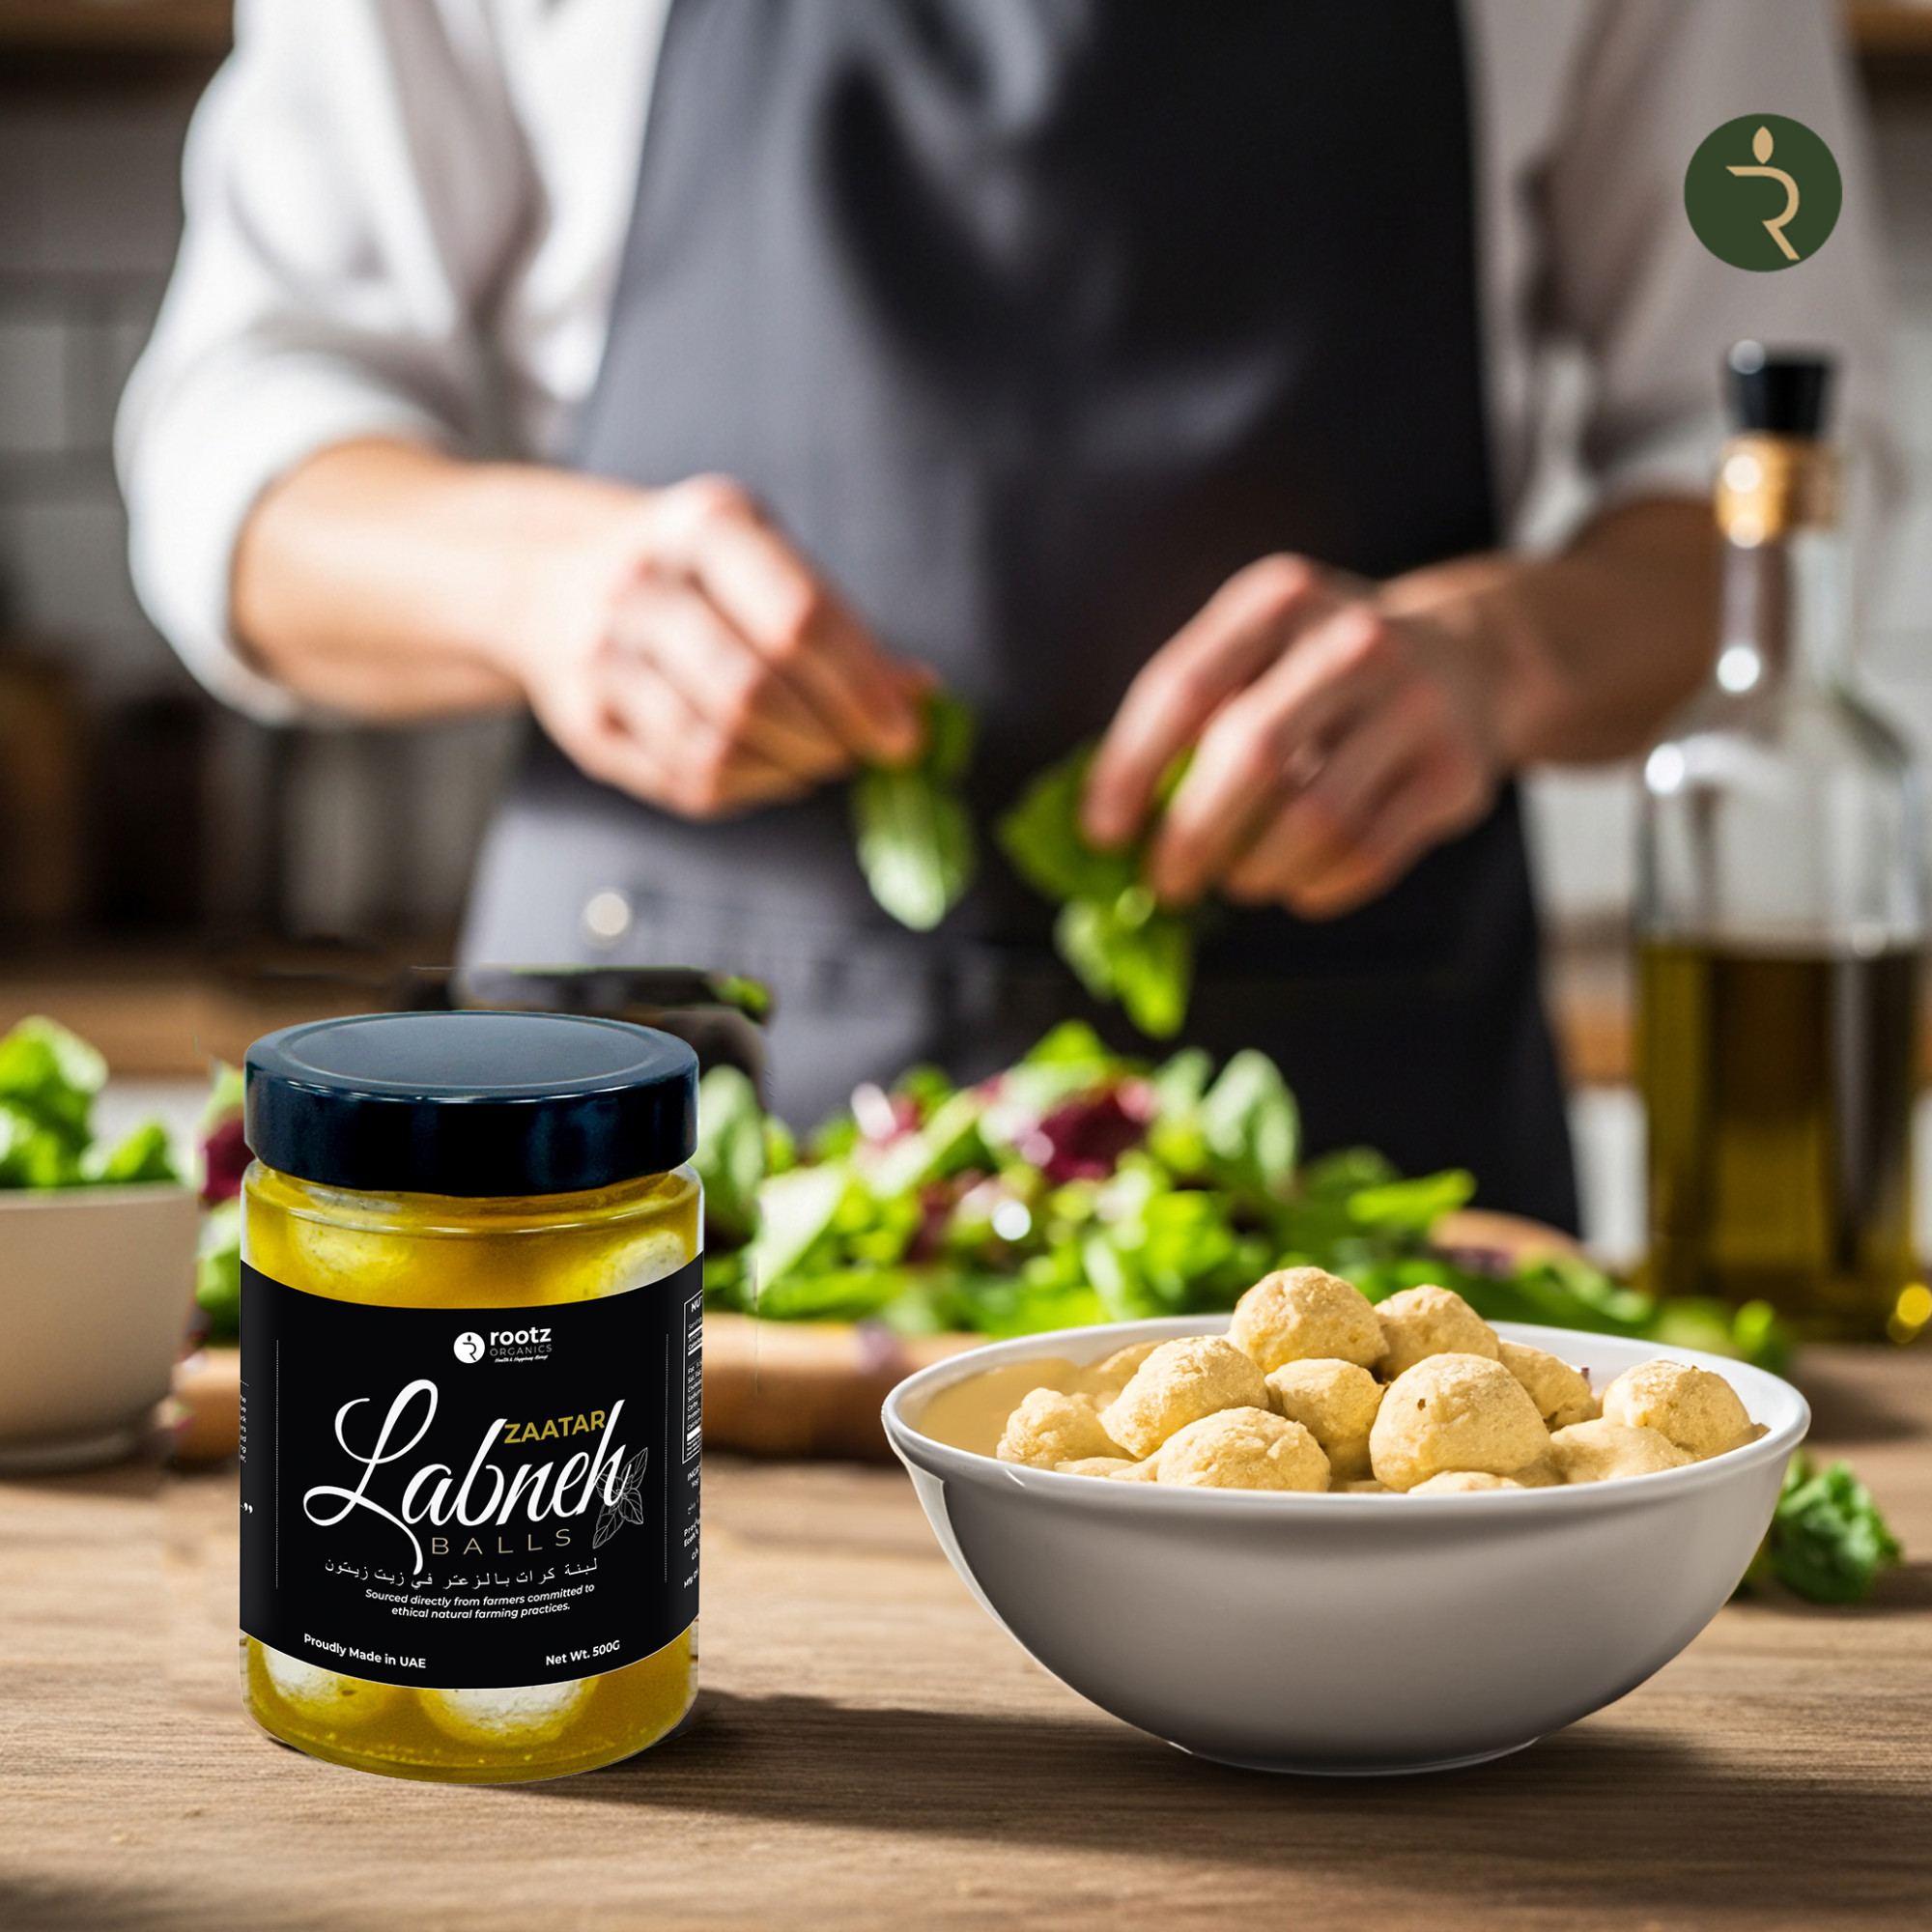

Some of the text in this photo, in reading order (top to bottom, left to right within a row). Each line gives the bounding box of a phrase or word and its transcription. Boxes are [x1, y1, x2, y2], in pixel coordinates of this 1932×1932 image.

[490, 1326, 552, 1347] rootz
[489, 1344, 553, 1357] ORGANICS
[504, 1409, 606, 1444] ZAATAR
[302, 1378, 632, 1576] Labneh
[431, 1528, 572, 1555] BALLS
[325, 1557, 598, 1590] لبنة كرات بالزعتر في زيت زيتون
[364, 1583, 595, 1608] Sourced directly from farmers committed to
[391, 1603, 571, 1620] ethical natural farming practices.
[303, 1633, 427, 1669] Proudly Made in UAE
[545, 1639, 620, 1666] Net Wt. 500G
